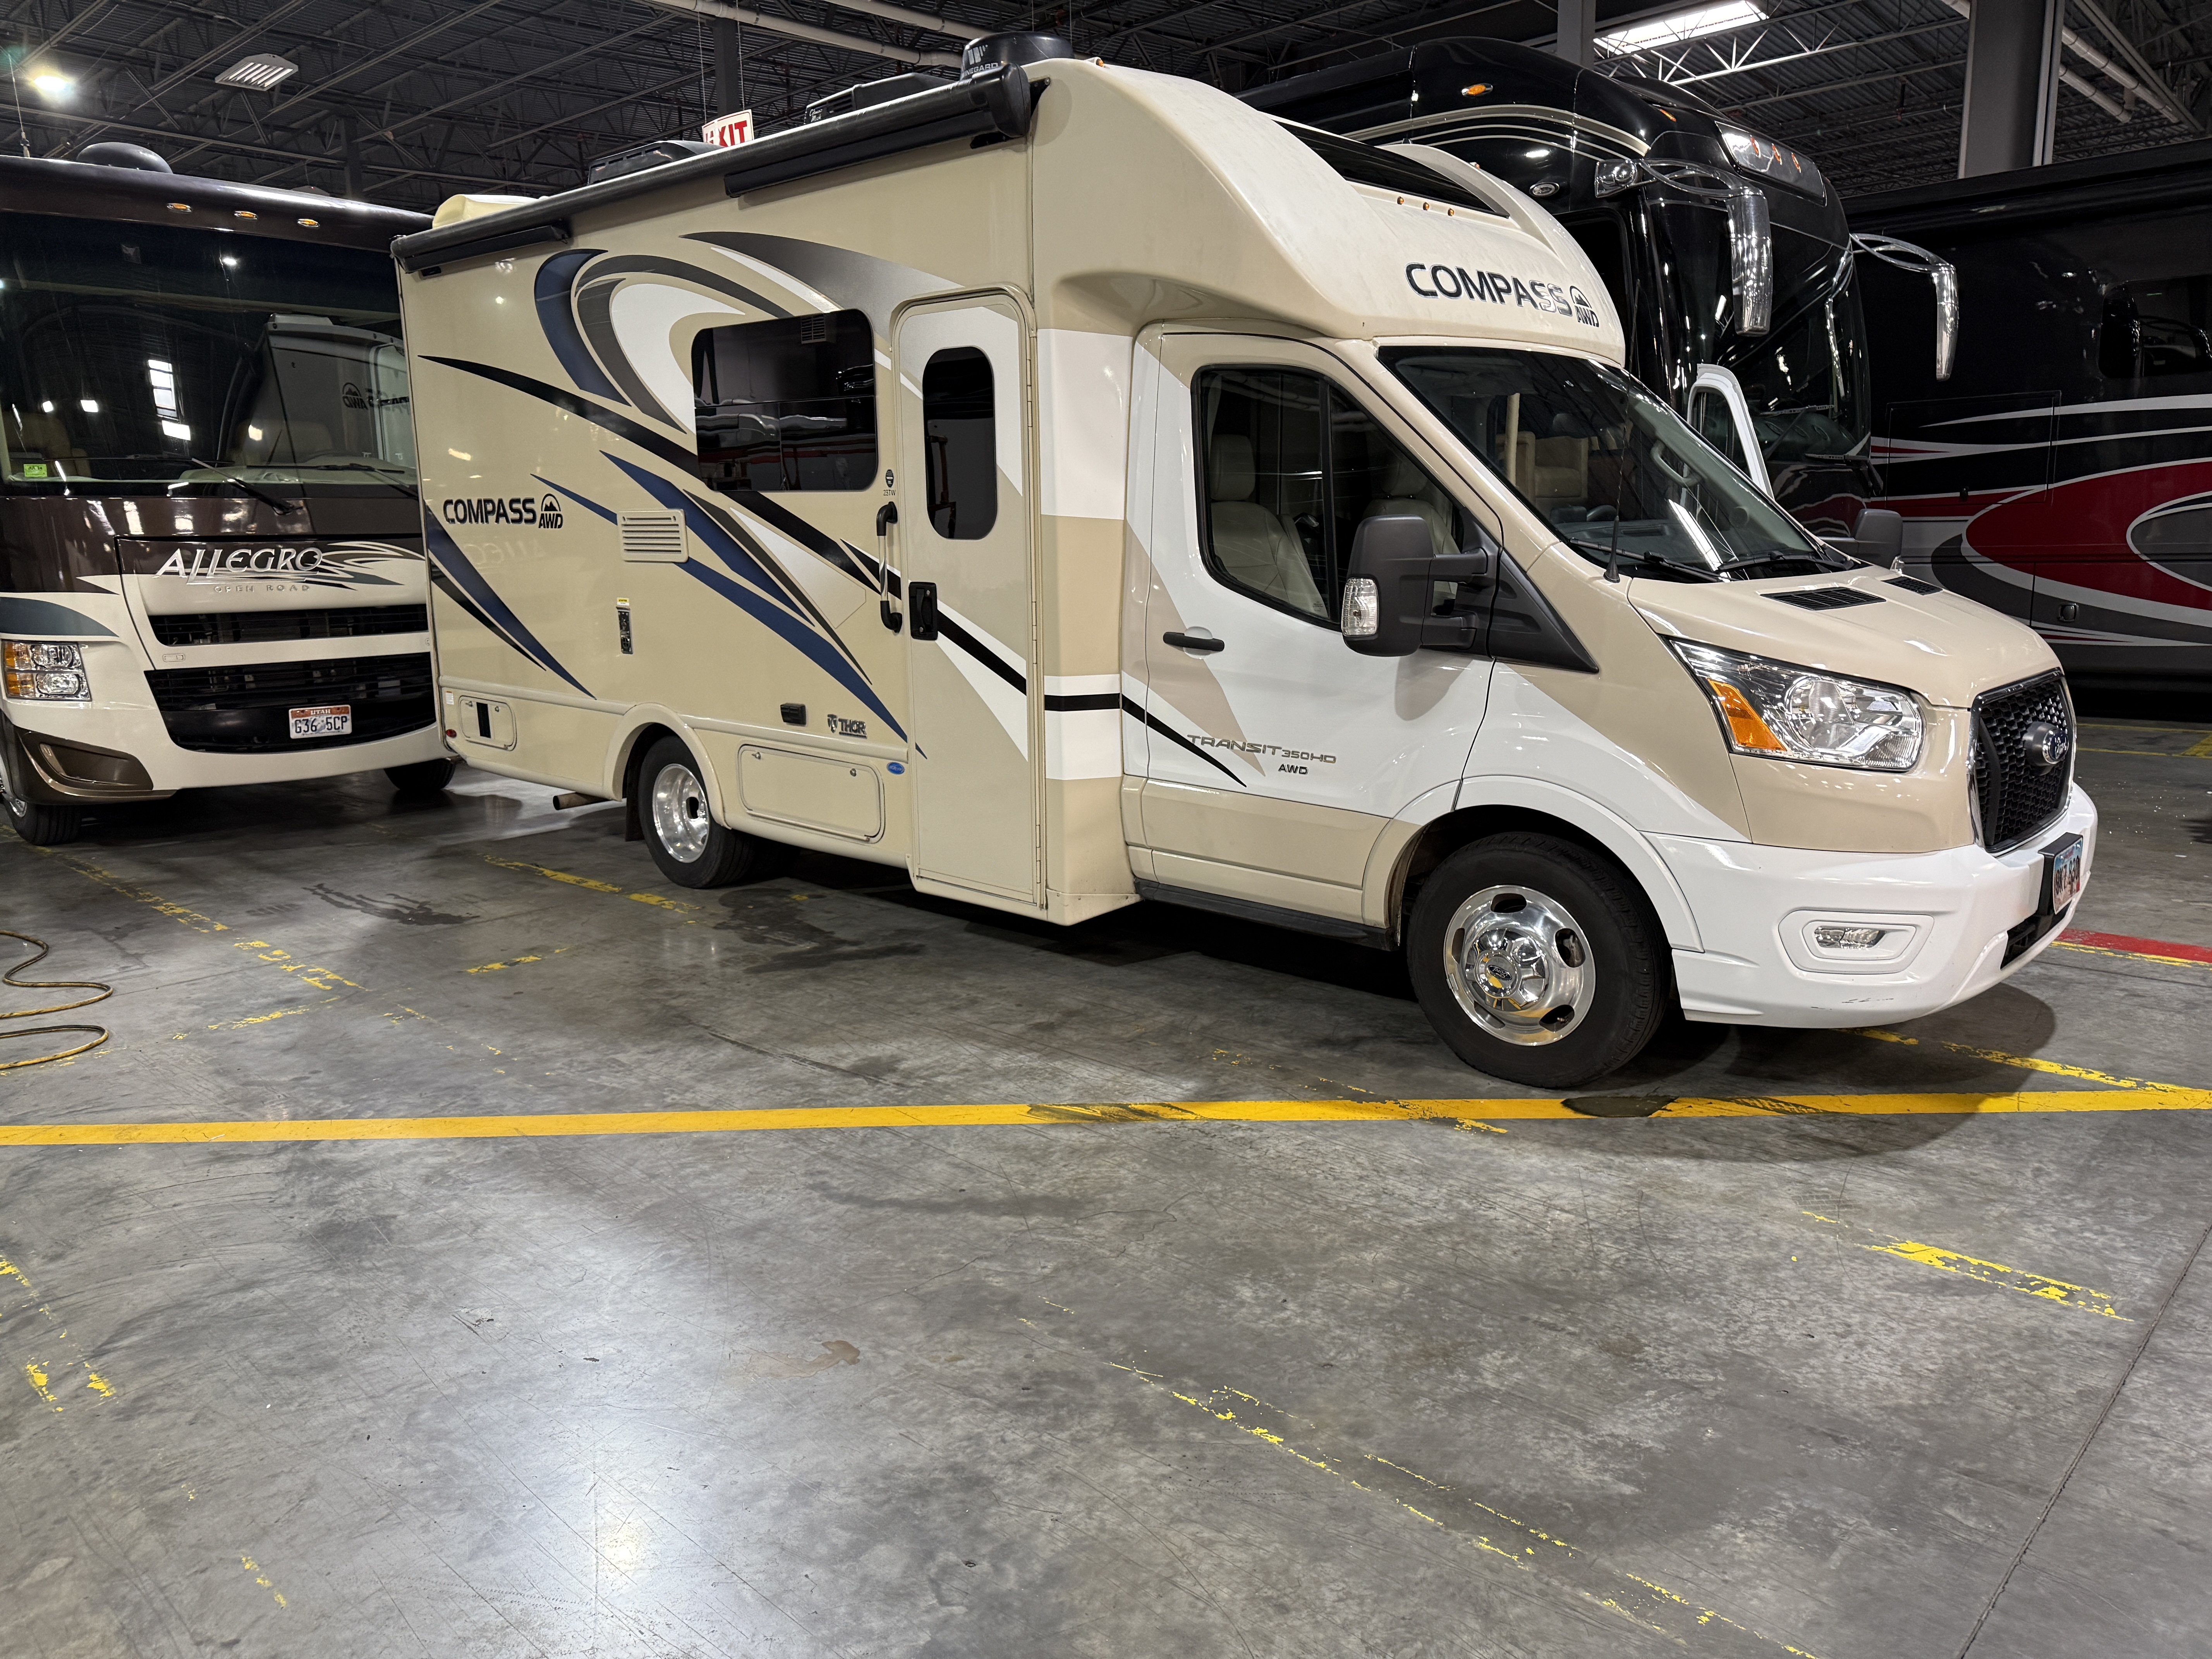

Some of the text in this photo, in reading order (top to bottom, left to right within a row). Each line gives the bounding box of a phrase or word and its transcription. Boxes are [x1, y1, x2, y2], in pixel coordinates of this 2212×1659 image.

[1405, 262, 1599, 328] COMPASS AWD
[443, 498, 563, 529] COMPASS AWD
[152, 547, 323, 585] ALLEGRO
[295, 716, 347, 733] G36 5CP
[838, 718, 867, 735] THOR
[1278, 764, 1309, 775] AWD
